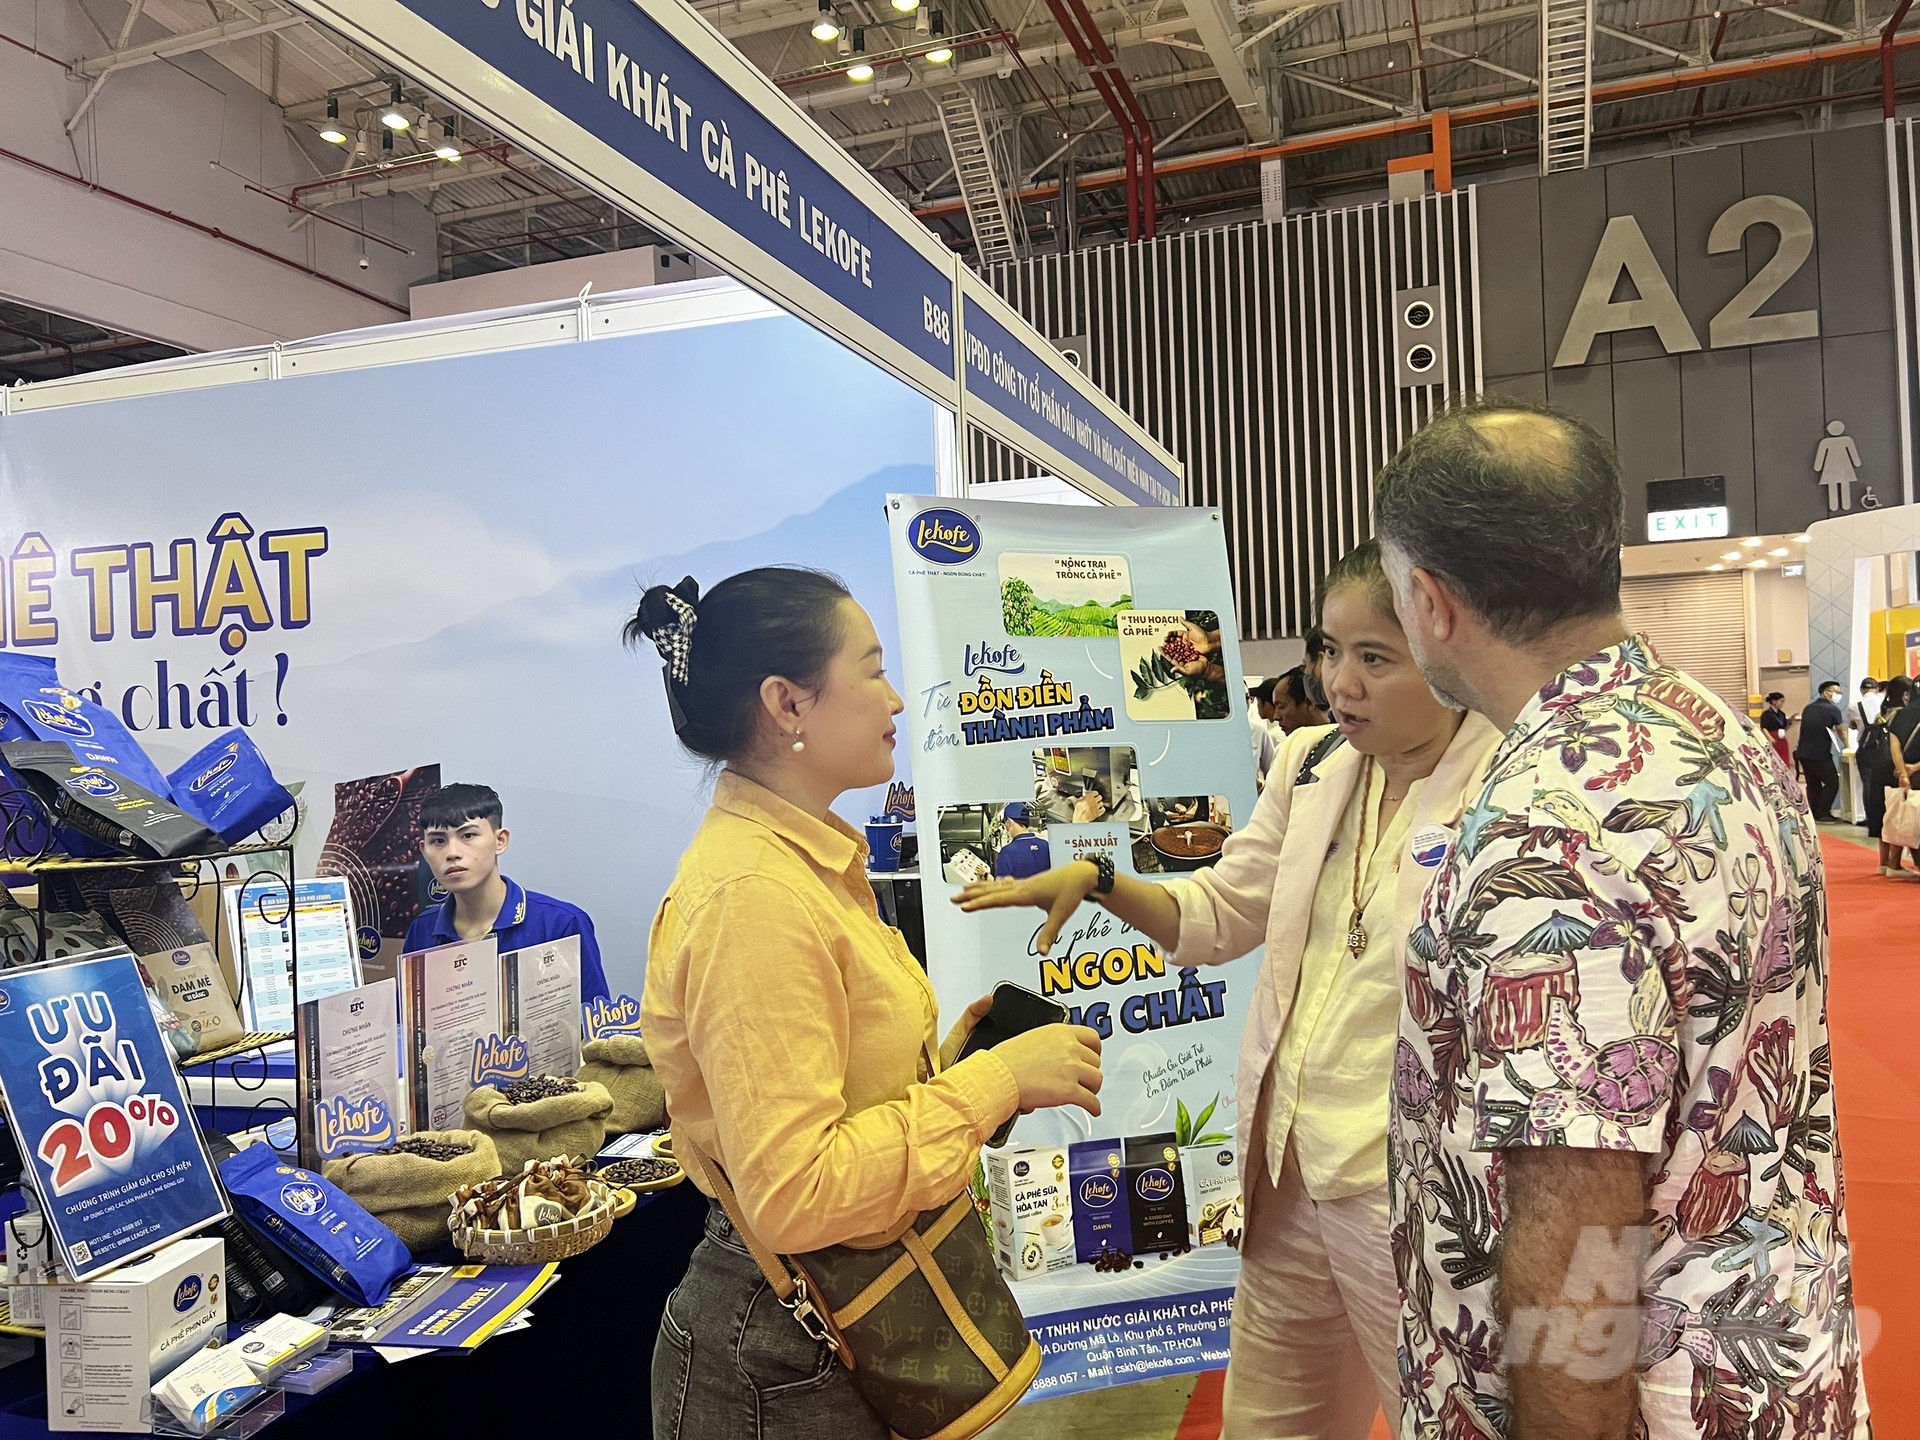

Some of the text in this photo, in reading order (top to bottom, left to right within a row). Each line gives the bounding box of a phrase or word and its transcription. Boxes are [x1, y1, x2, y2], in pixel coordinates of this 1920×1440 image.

[607, 41, 693, 153] KHÁT
[701, 119, 737, 189] CÀ
[745, 152, 791, 229] PHÊ
[800, 196, 873, 289] LEKOFE
[1552, 194, 1819, 368] A2
[923, 294, 950, 346] B88
[965, 329, 991, 377] VPĐD
[993, 350, 1017, 398] CÔNG
[1017, 371, 1028, 404] TY
[1030, 372, 1040, 414] CỔ
[917, 518, 973, 553] Lekofe
[1656, 513, 1718, 531] EXIT
[1061, 557, 1106, 570] NÔNG TRẠI
[1087, 569, 1097, 579] CÀ
[1099, 570, 1116, 580] PHÊ
[71, 512, 328, 655] THẬT
[1123, 625, 1153, 636] CÀ PHÊ
[1128, 616, 1179, 626] THU HOẠCH
[964, 641, 1025, 676] Lekofe
[121, 659, 257, 732] chất
[958, 675, 1014, 714] ĐỒN
[1016, 669, 1072, 708] ĐIỀN
[961, 709, 1045, 745] THÀNH
[1047, 695, 1114, 735] PHẨM
[85, 753, 118, 764] DAWN
[210, 777, 234, 797] DAWN
[1072, 832, 1118, 848] SẢN XUẤT
[1064, 912, 1112, 962] phê
[453, 958, 468, 968] EFC
[543, 954, 555, 964] EFC
[1040, 944, 1166, 996] NGON
[171, 975, 212, 994] ĐAM MÊ
[1120, 967, 1226, 1034] CHẤT
[28, 993, 114, 1046] ƯU
[350, 1001, 364, 1013] EFC
[585, 998, 640, 1041] Lekofe
[43, 1034, 143, 1105] ĐÃI
[474, 1037, 529, 1083] Lekofe
[1167, 1059, 1178, 1071] Gu
[42, 1098, 175, 1189] 20%
[320, 1100, 391, 1154] Lekofe
[65, 1160, 192, 1215] CHƯƠNG TRÌNH GIẢM GIÁ CHO SỰ KIỆN
[1015, 1185, 1058, 1202] CÀ PHÊ SỮA
[1085, 1182, 1113, 1200] Lekofe
[1142, 1175, 1170, 1194] Lekofe
[1016, 1199, 1048, 1213] HÒA TAN
[88, 1231, 113, 1246] HOTLINE:
[112, 1227, 122, 1237] 032
[94, 1223, 161, 1257] WEBSITE: WWW.LEKOFE.COM
[1093, 1223, 1112, 1231] DAWN
[160, 1339, 170, 1351] CÀ
[171, 1328, 185, 1344] PHÊ
[185, 1319, 201, 1336] PHIN
[202, 1308, 218, 1325] GIẤY
[1046, 1321, 1080, 1338] TNHH
[1083, 1314, 1121, 1331] NƯỚC
[1125, 1309, 1150, 1325] GIẢI
[1153, 1304, 1187, 1321] KHÁT
[1190, 1301, 1208, 1316] CÀ
[1210, 1297, 1234, 1313] PHÊ
[1052, 1340, 1087, 1354] Đường
[1089, 1335, 1106, 1347] Mã
[1124, 1330, 1144, 1341] Khu
[1146, 1324, 1164, 1340] phố
[1178, 1320, 1216, 1333] Phường
[1087, 1349, 1114, 1362] Quận
[1139, 1344, 1162, 1354] Tân,
[1162, 1337, 1202, 1351] TP.HCM
[1032, 1376, 1058, 1390] 8888
[1060, 1371, 1078, 1384] 057
[1087, 1365, 1113, 1378] Mail:
[1115, 1356, 1195, 1374] cskh@lekofe.com
